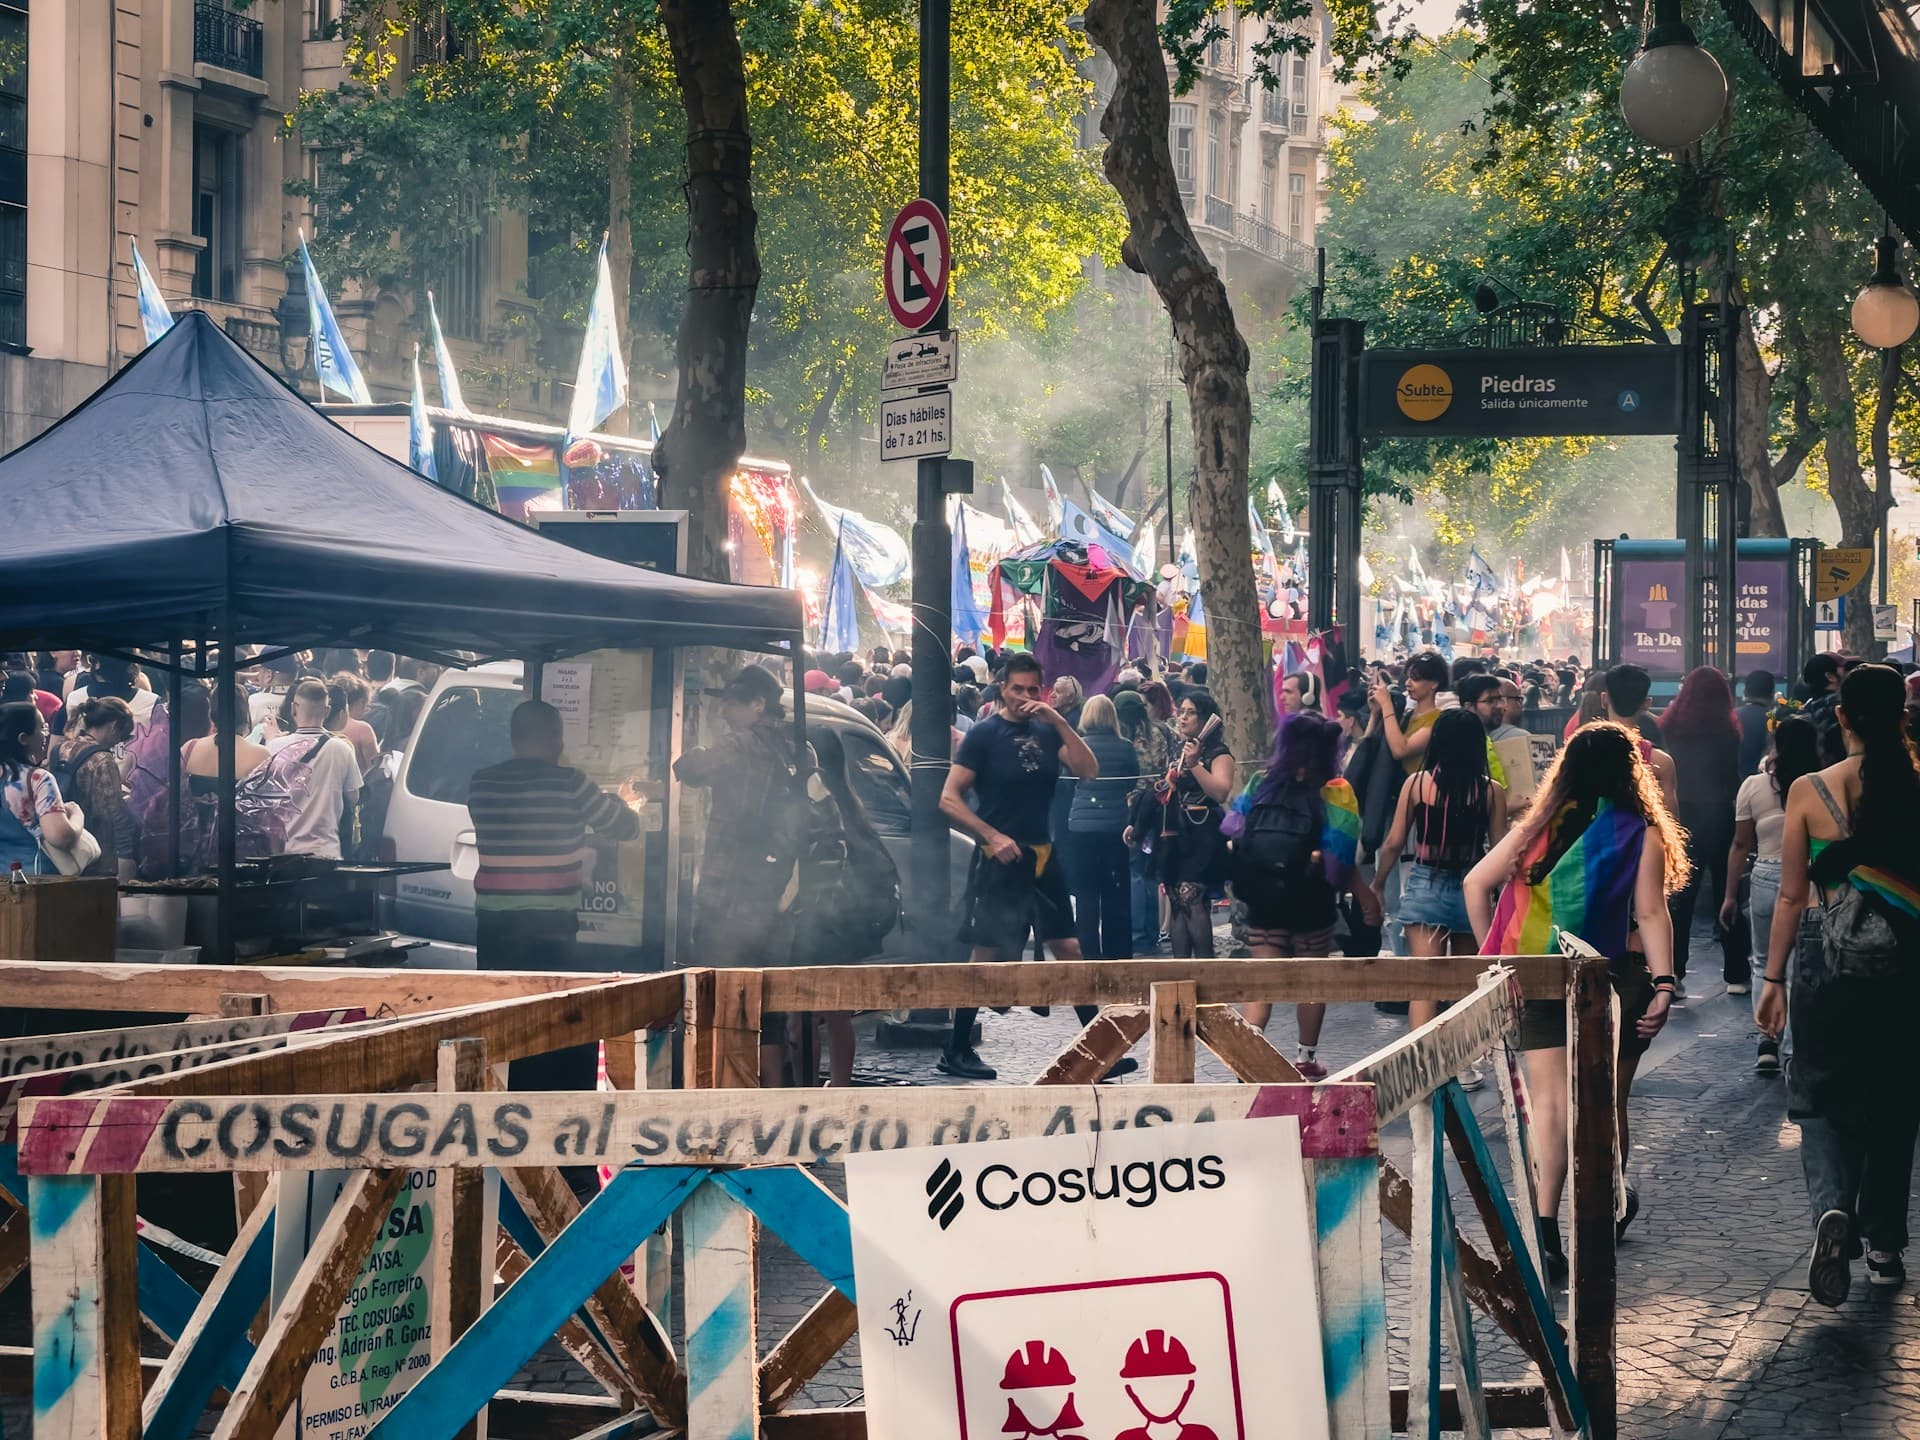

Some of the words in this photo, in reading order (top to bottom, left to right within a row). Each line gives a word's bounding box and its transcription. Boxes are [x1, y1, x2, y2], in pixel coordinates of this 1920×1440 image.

[1404, 383, 1445, 397] Subte
[1480, 374, 1556, 393] Piedras
[1480, 398, 1515, 409] Salida
[1519, 397, 1588, 409] únicamente
[1622, 393, 1637, 407] A
[910, 406, 945, 423] hábiles
[885, 434, 897, 449] de
[899, 433, 905, 447] 7
[908, 435, 914, 446] a
[916, 429, 927, 445] 21
[931, 428, 946, 442] hs.
[1742, 584, 1768, 595] tus
[162, 1102, 532, 1160] COSUGAS
[553, 1103, 616, 1155] al
[632, 1104, 909, 1157] servicio
[976, 1154, 1227, 1208] Cosugas
[369, 1249, 404, 1273] AYSA:
[372, 1273, 423, 1298] Ferreiro
[339, 1314, 359, 1335] TEC.
[362, 1302, 415, 1330] COSUGAS
[386, 1328, 397, 1347] R.
[371, 1365, 393, 1380] Reg.
[408, 1353, 431, 1370] 2000
[305, 1406, 352, 1430] PERMISO
[354, 1401, 368, 1417] EN
